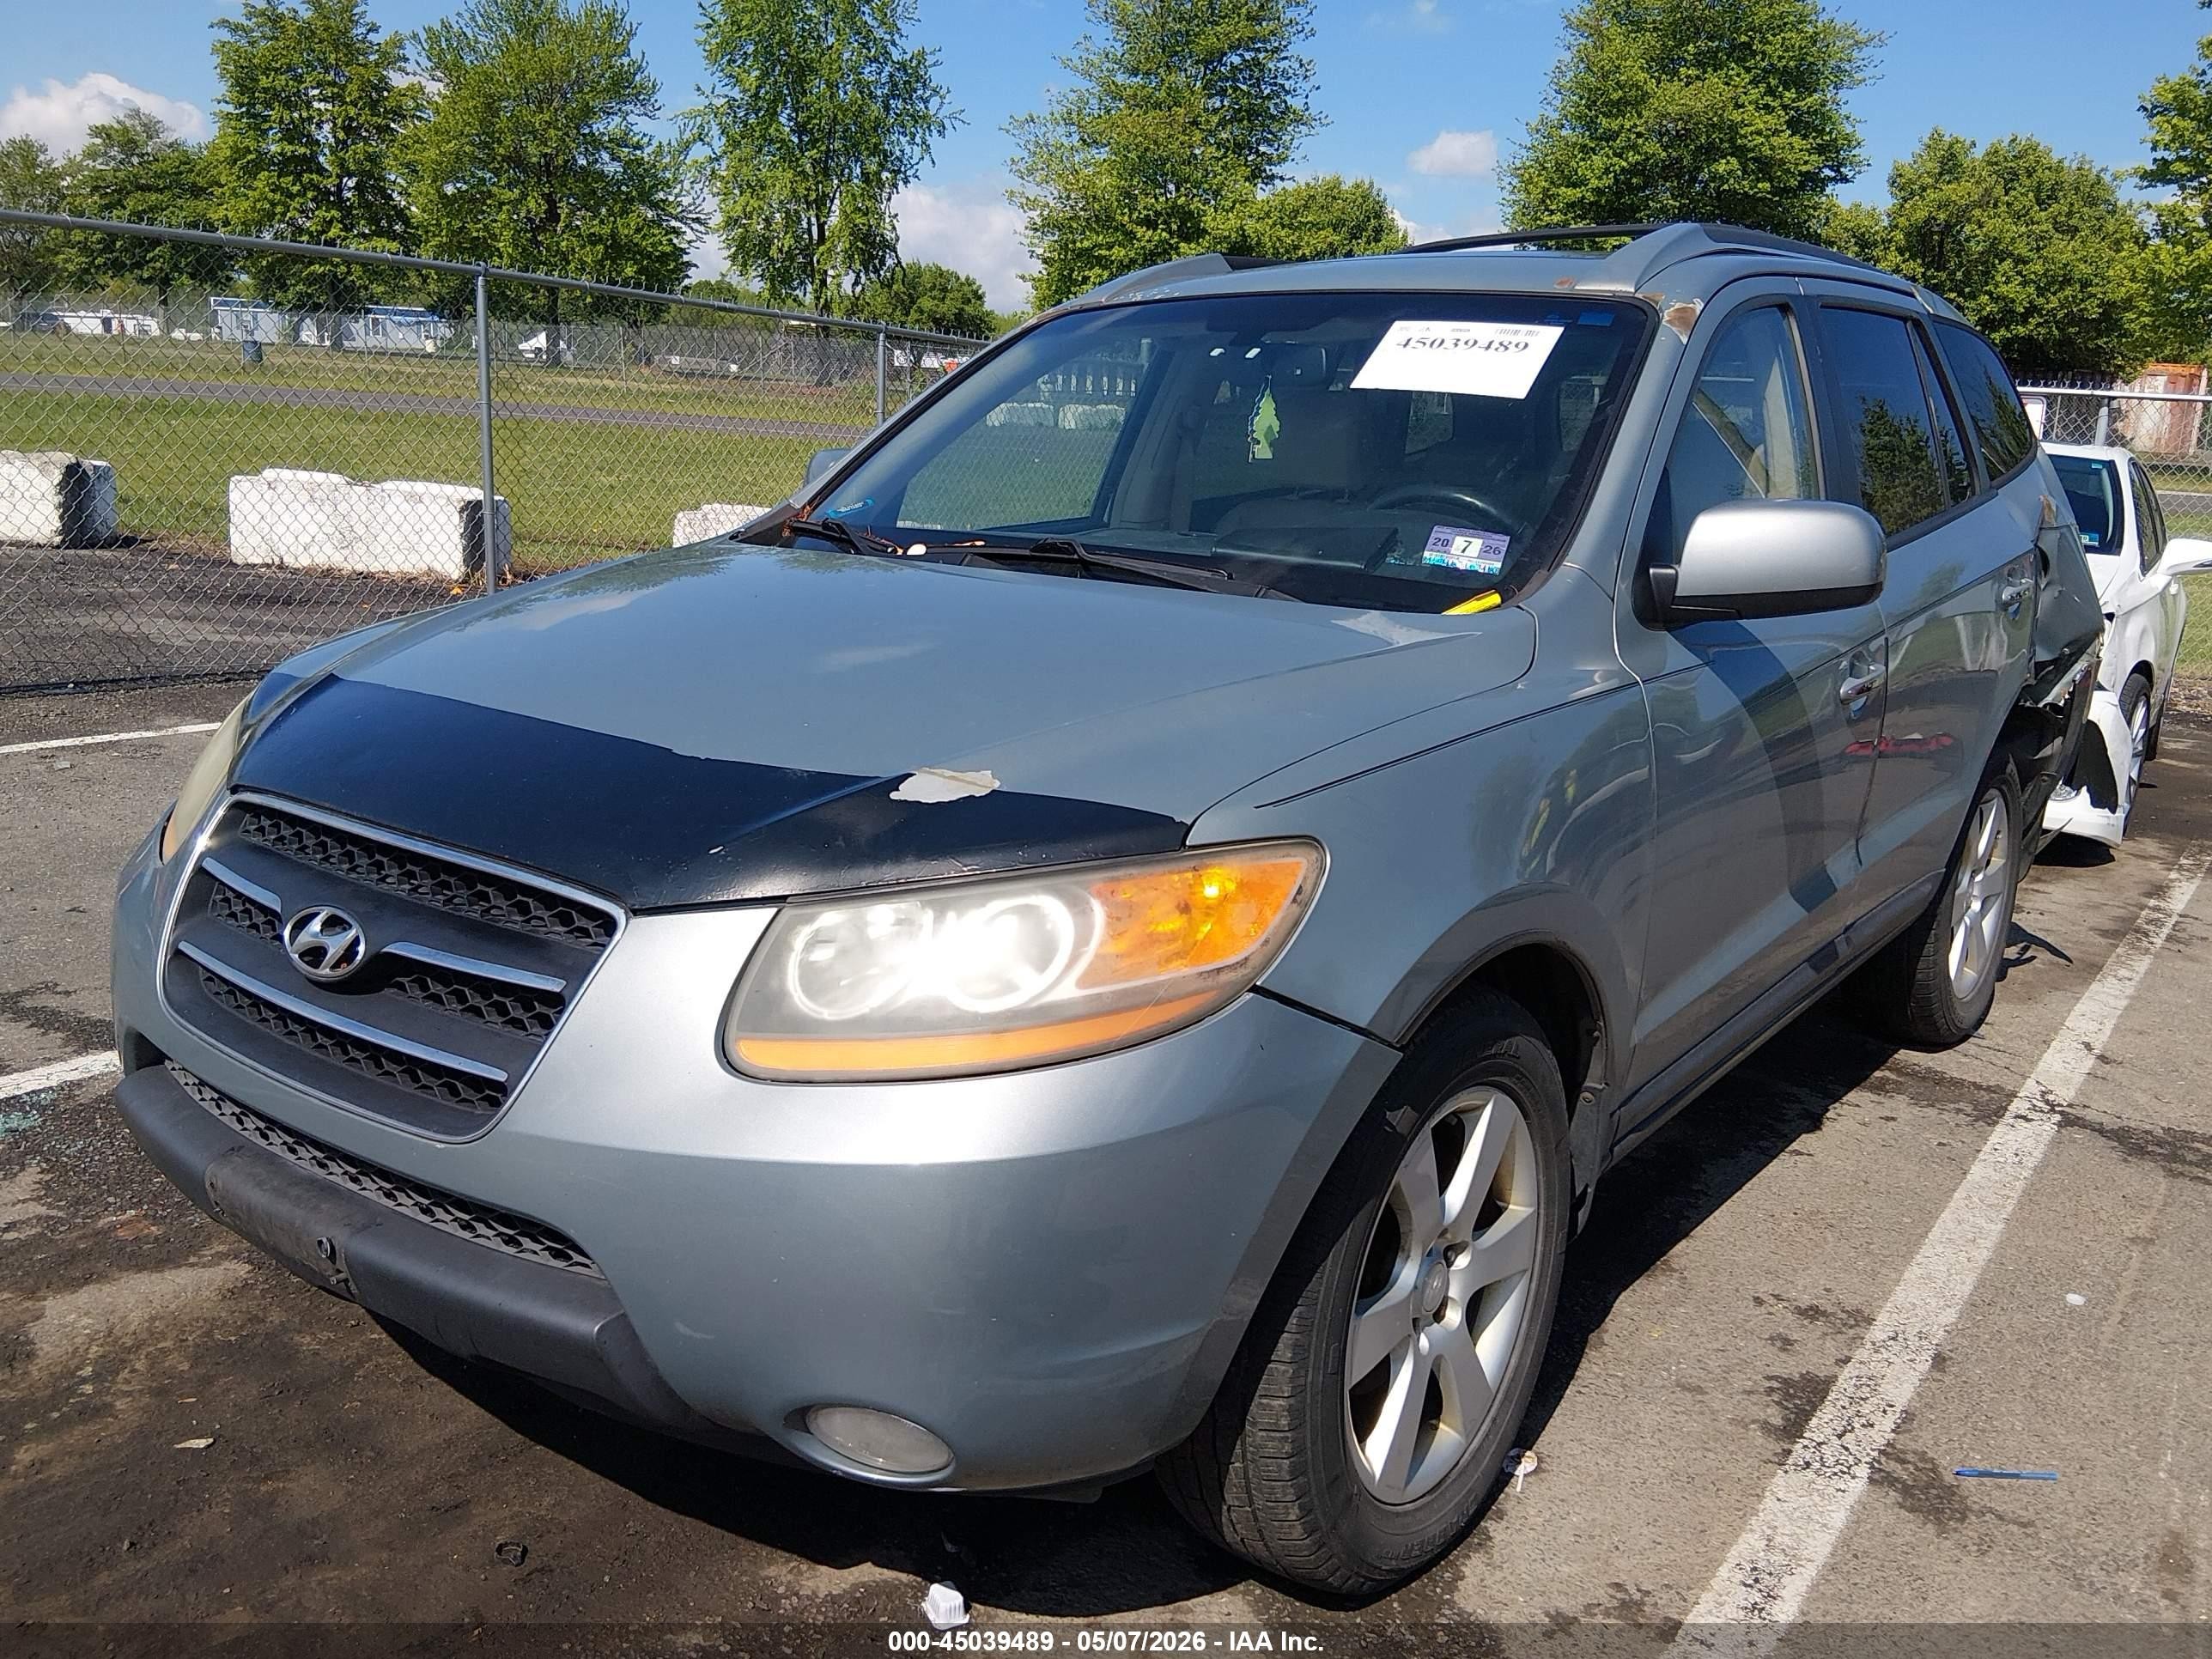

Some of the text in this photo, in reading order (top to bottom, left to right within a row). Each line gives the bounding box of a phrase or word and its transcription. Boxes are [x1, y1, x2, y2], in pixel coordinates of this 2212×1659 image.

[1396, 337, 1529, 353] 45039489
[1432, 537, 1502, 556] 20 7 26
